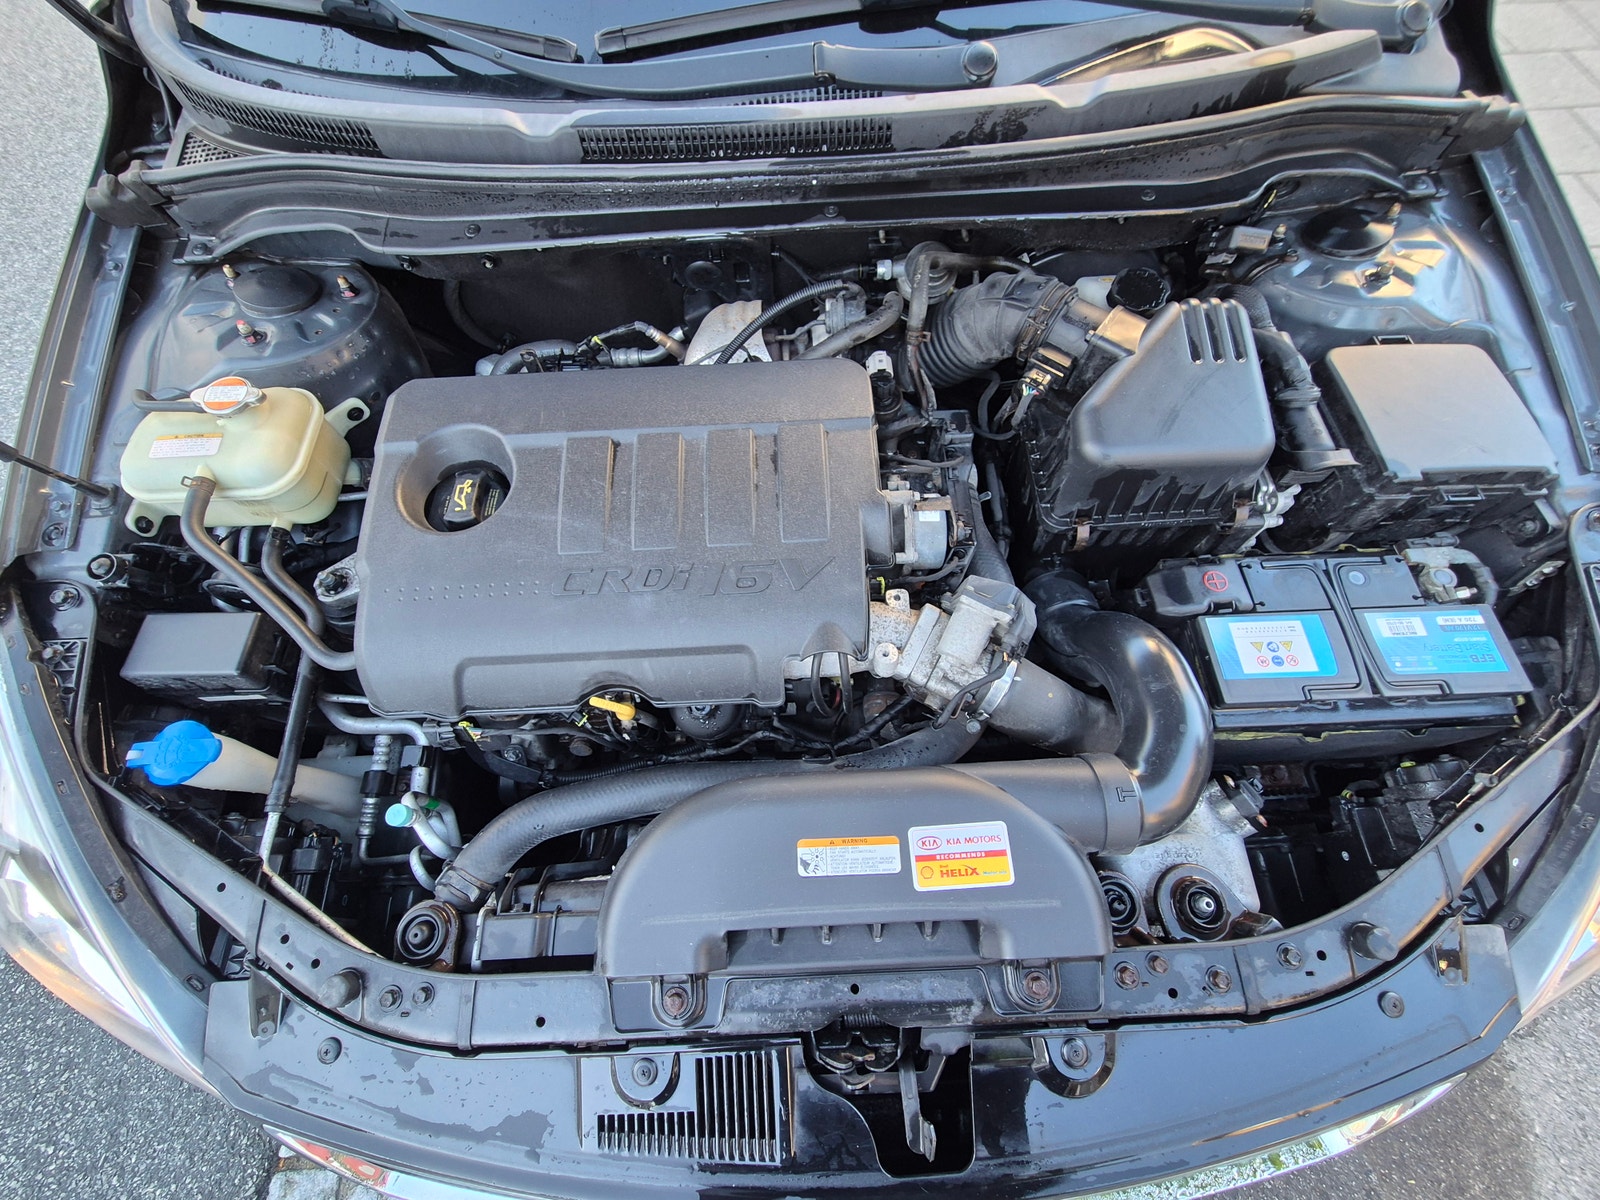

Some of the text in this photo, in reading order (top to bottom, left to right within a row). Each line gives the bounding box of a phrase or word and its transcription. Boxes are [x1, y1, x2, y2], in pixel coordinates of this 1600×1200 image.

[1469, 653, 1497, 663] EFB
[921, 839, 938, 847] KIA
[964, 835, 1002, 845] MOTORS
[936, 851, 986, 860] RECOMMENDS
[940, 866, 980, 878] HELIX
